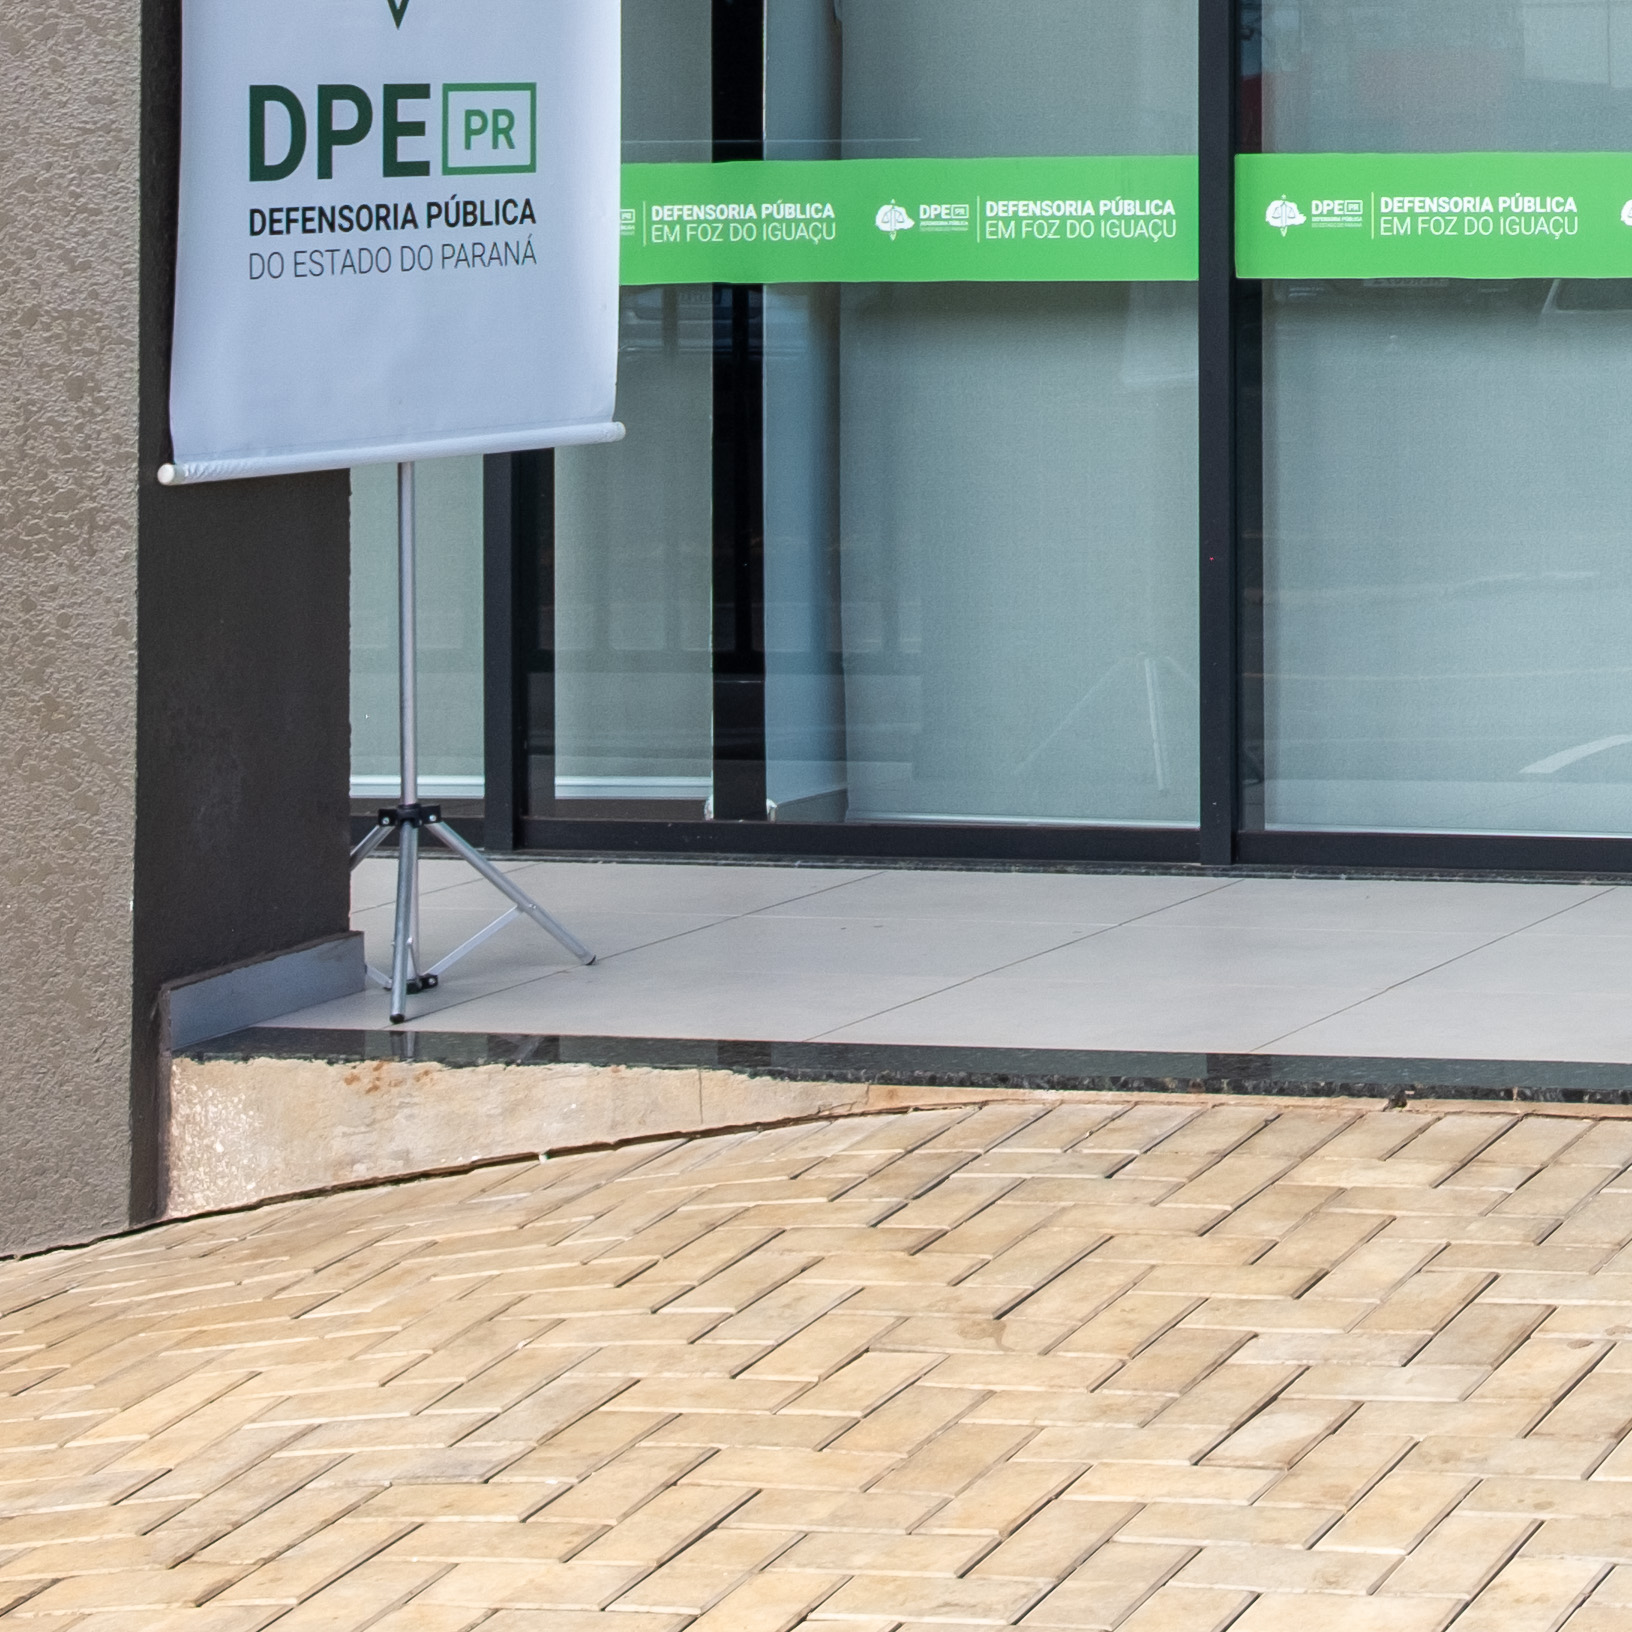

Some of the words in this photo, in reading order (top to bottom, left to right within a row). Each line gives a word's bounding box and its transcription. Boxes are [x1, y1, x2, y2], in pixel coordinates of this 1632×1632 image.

[249, 83, 431, 182] DPE
[463, 108, 516, 150] PR
[249, 202, 419, 237] DEFENSORIA
[426, 193, 537, 229] PÚBLICA
[652, 203, 758, 221] DEFENSORIA
[761, 199, 836, 220] PÚBLICA
[919, 204, 951, 219] DPE
[986, 200, 1095, 217] DEFENSORIA
[1099, 196, 1176, 216] PÚBLICA
[1311, 200, 1344, 215] DPE
[1380, 196, 1494, 213] DEFENSORIA
[1498, 193, 1578, 213] PÚBLICA
[652, 224, 680, 243] EM
[686, 223, 724, 242] FOZ
[729, 222, 757, 241] DO
[763, 221, 836, 245] IGUAÇU
[986, 220, 1015, 239] EM
[1021, 220, 1060, 239] FOZ
[1066, 219, 1095, 238] DO
[1100, 218, 1177, 242] IGUAÇU
[1380, 216, 1411, 236] EM
[1417, 216, 1458, 236] FOZ
[1464, 216, 1494, 235] DO
[1499, 215, 1578, 240] IGUAÇU
[249, 251, 285, 280] DO
[293, 246, 392, 278] ESTADO
[400, 243, 434, 272] DO
[441, 233, 538, 269] PARANÁ
